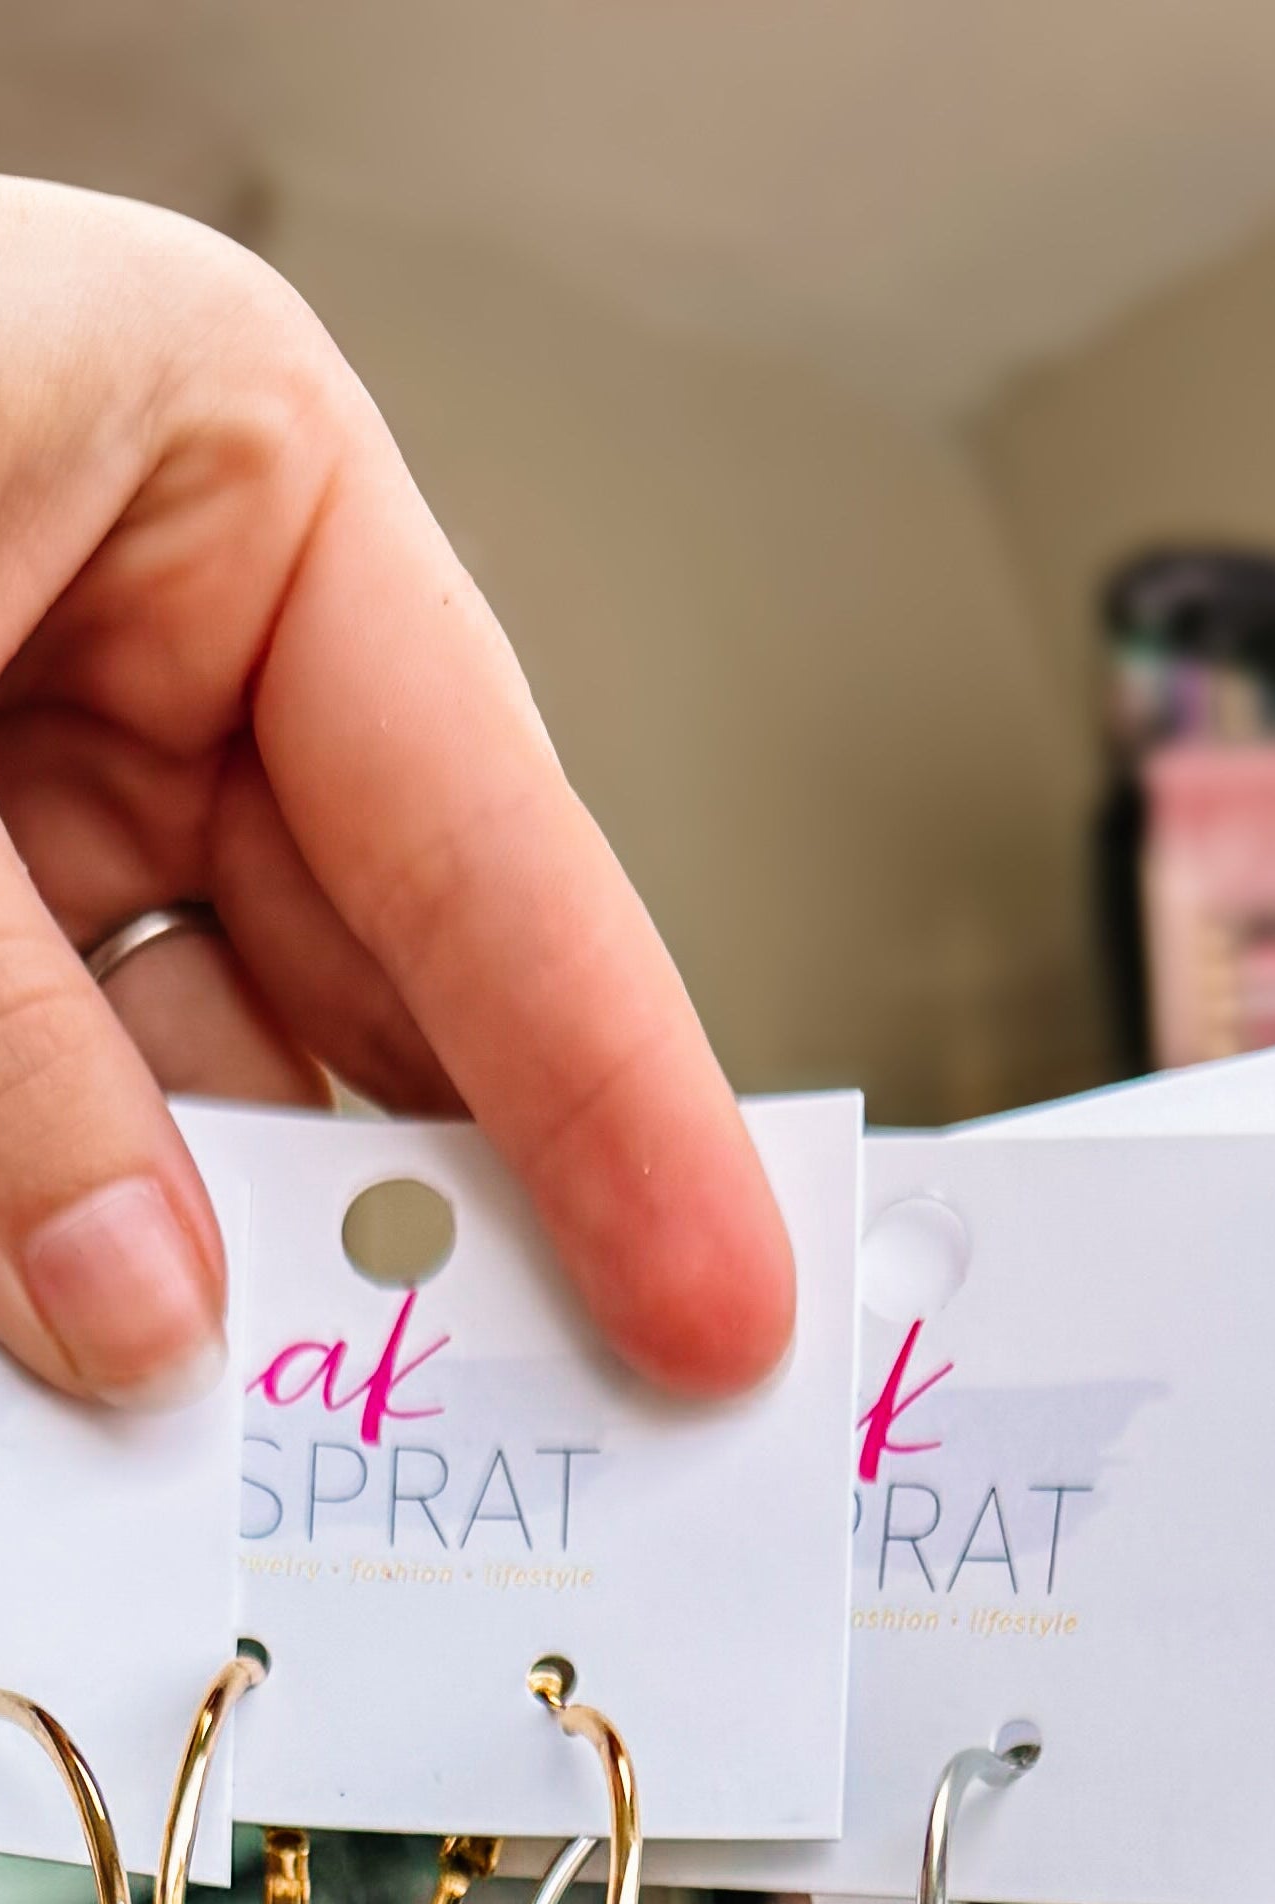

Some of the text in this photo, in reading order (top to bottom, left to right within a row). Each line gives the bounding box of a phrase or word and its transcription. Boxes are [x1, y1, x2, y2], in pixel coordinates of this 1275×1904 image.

[245, 1287, 452, 1446] ak
[349, 1557, 454, 1585] fashion
[483, 1560, 596, 1592] lifestyle
[852, 1482, 1094, 1595] RAT
[851, 1606, 1079, 1638] ashion lifestyle
